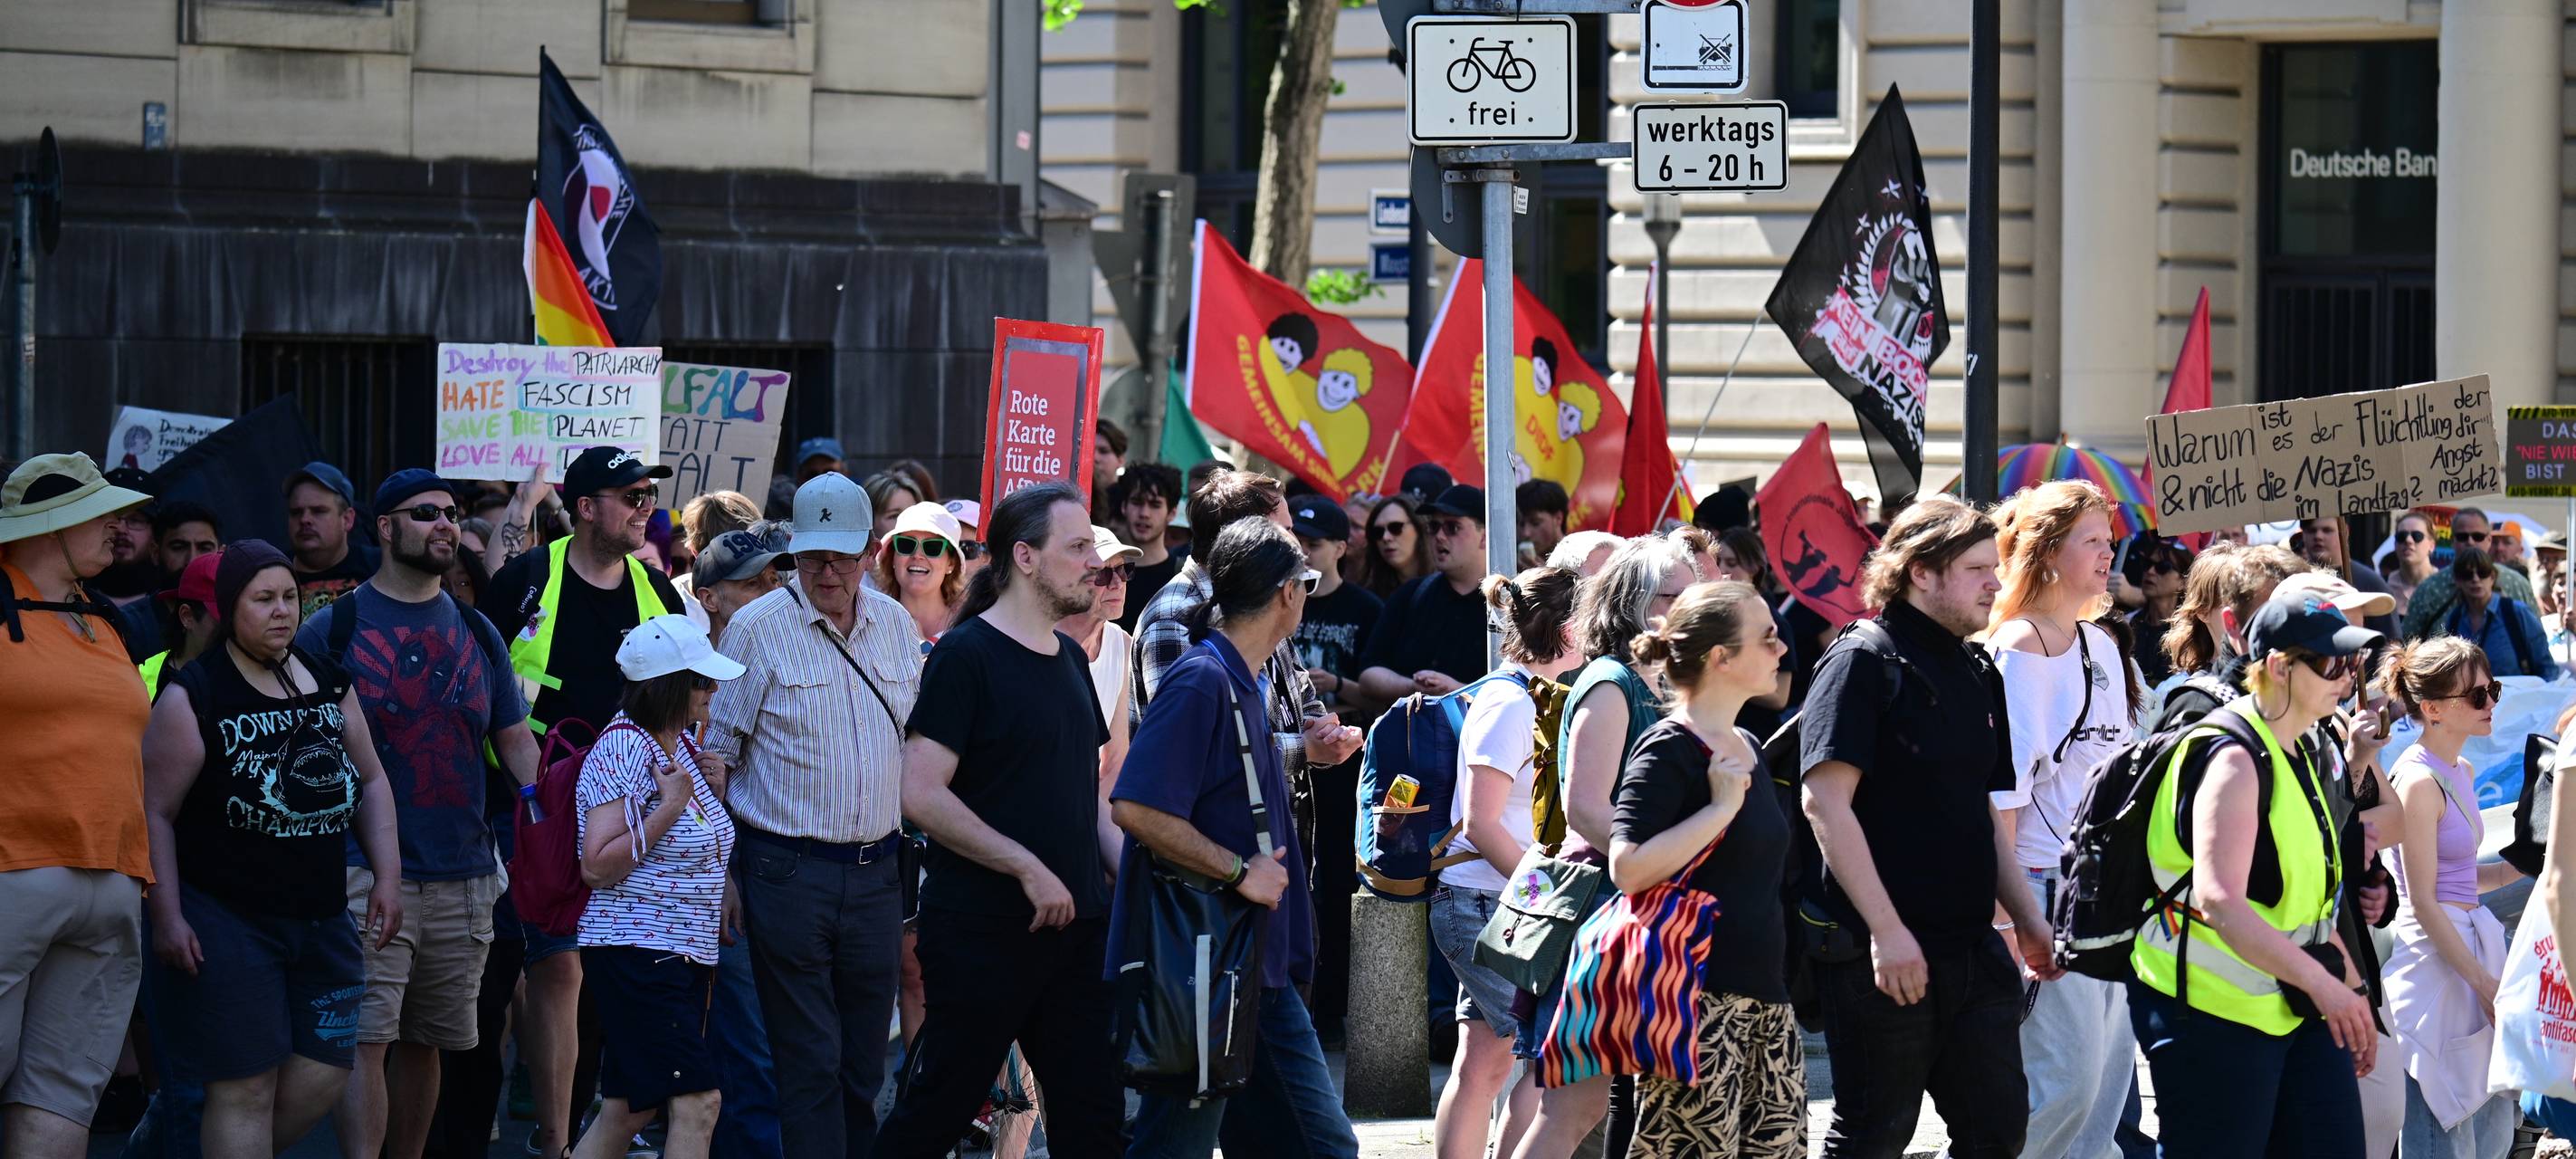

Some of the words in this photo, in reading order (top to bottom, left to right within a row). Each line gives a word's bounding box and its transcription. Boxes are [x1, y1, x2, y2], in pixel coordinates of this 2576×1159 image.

[1468, 101, 1516, 126] frei
[1646, 115, 1775, 149] werktags
[1658, 154, 1673, 181] 6
[1708, 153, 1739, 181] 20
[1750, 153, 1764, 181] h
[2289, 147, 2391, 177] Deutsche
[2395, 147, 2438, 177] Ban
[444, 348, 537, 385] Destroy
[542, 351, 569, 374] the
[573, 351, 663, 377] PATRIARCHY
[442, 379, 505, 412] HATE
[522, 380, 632, 407] FASCISM
[661, 364, 788, 423] LFALT
[1009, 389, 1048, 416] Rote
[1856, 353, 1924, 429] NAZIS
[2454, 384, 2489, 409] der
[440, 413, 500, 443] SAVE
[554, 414, 644, 438] PLANET
[1007, 419, 1056, 446] Karte
[2257, 402, 2293, 430] ist
[2311, 410, 2343, 445] der
[2354, 392, 2452, 447] Flüchtling
[441, 443, 500, 468] LOVE
[510, 444, 551, 467] ALL
[2152, 416, 2256, 469] Warum
[2272, 432, 2294, 451] es
[2430, 437, 2483, 476] Angst
[1005, 446, 1032, 473] für
[1033, 449, 1061, 476] die
[2294, 454, 2375, 492] Nazis
[2525, 463, 2565, 480] BIST
[2190, 467, 2247, 511] nicht
[2256, 467, 2288, 502] die
[2338, 475, 2423, 517] Landtag?
[2438, 464, 2498, 499] macht?
[2295, 494, 2320, 520] im
